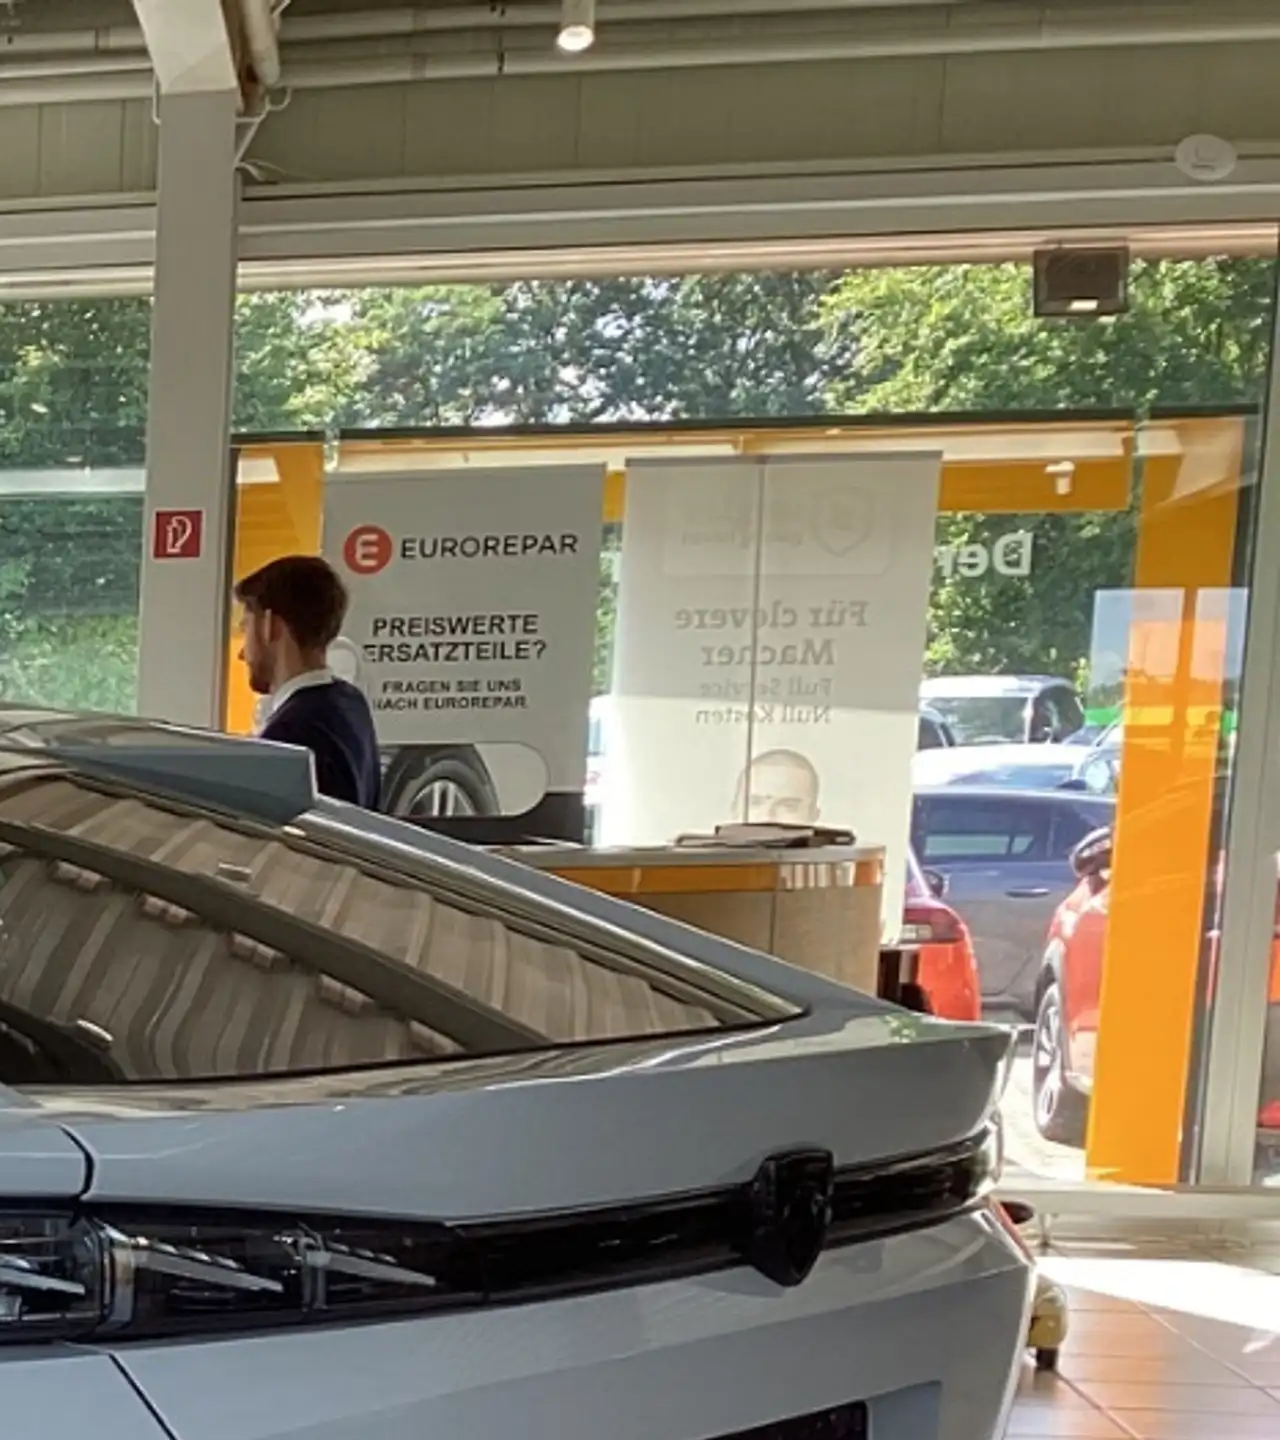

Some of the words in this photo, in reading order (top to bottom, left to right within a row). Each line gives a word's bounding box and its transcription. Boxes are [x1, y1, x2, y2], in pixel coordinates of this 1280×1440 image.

[400, 534, 579, 559] EUROREPAR
[371, 614, 539, 638] PREISWERTE
[362, 639, 547, 663] ERSATZTEILE?
[381, 680, 450, 694] FRAGEN
[456, 679, 480, 694] SIE
[487, 678, 522, 693] UNS
[423, 695, 527, 710] EUROREPAR
